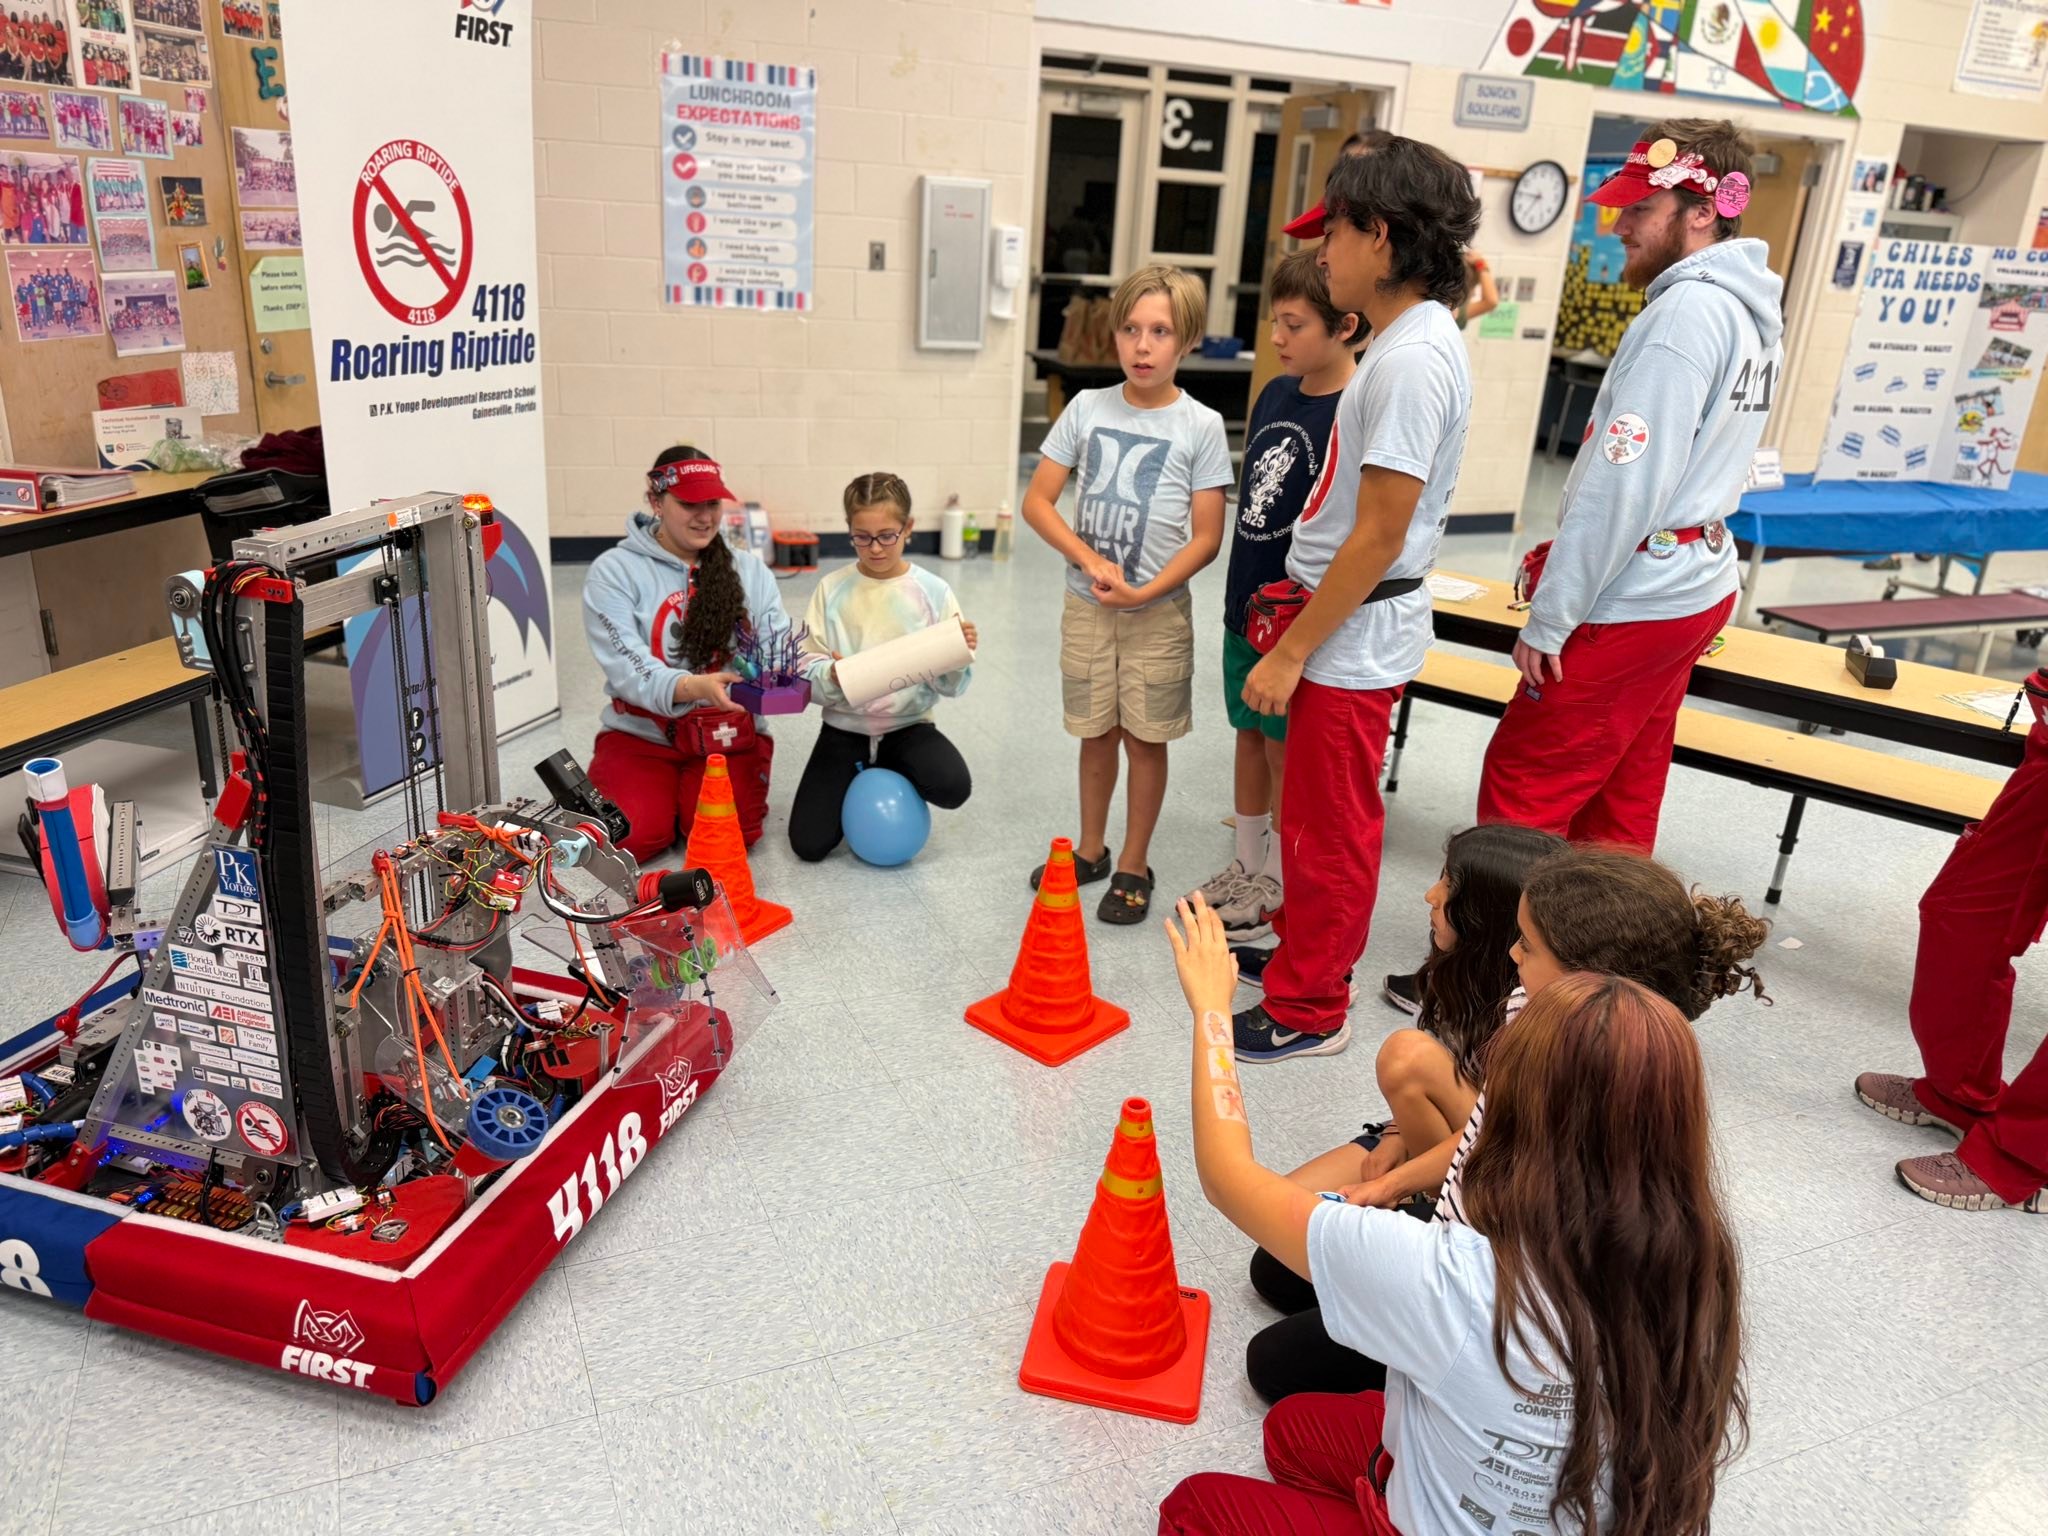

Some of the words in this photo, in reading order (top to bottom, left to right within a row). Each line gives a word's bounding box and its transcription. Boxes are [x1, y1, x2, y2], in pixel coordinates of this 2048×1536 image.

[455, 13, 513, 47] FIRST
[690, 85, 791, 108] LUNCHROOM
[677, 104, 801, 131] EXPECTATIONS
[705, 132, 728, 145] Stay
[731, 134, 742, 143] in
[745, 136, 767, 148] your
[361, 142, 412, 187] ROARING
[416, 145, 459, 193] RIPTIDE
[1888, 242, 1973, 266] CHILES
[1992, 248, 2017, 260] NO
[1871, 267, 1906, 288] PTA
[1914, 270, 1981, 292] NEEDS
[472, 283, 525, 322] 4118
[1879, 296, 1956, 327] YOU!
[408, 308, 436, 324] 4118
[331, 334, 444, 382] Roaring
[451, 327, 535, 372] Riptide
[380, 404, 393, 416] P.K.
[395, 401, 420, 413] Yonge
[422, 392, 477, 410] Developmental
[479, 388, 513, 403] Research
[514, 385, 536, 398] School
[1270, 420, 1303, 435] ELEMENTARY
[1301, 429, 1314, 452] HONOR
[1081, 498, 1140, 543] HUR
[1241, 508, 1267, 528] 2025
[1250, 532, 1272, 541] Public
[220, 875, 257, 898] Yonge
[225, 926, 260, 946] RTX
[187, 953, 214, 966] Florida
[235, 953, 264, 962] ARGOSY
[188, 962, 213, 974] Credit
[213, 965, 239, 980] Union
[145, 991, 205, 1013] Medtronic
[176, 981, 216, 997] INTUITIVE
[221, 990, 269, 1008] Foundation
[211, 1005, 236, 1021] AEI
[237, 1010, 266, 1022] Affiliated
[237, 1016, 271, 1029] Engineers
[243, 1030, 254, 1039] The
[255, 1033, 273, 1043] Curry
[248, 1040, 269, 1051] Family
[262, 1083, 280, 1093] Slice
[658, 1079, 699, 1139] FIRST
[546, 1111, 647, 1248] 4118
[281, 1345, 377, 1389] FIRST
[1478, 1456, 1511, 1477] AEI
[1512, 1468, 1550, 1481] Affiliated
[1494, 1480, 1545, 1500] ARGOSY
